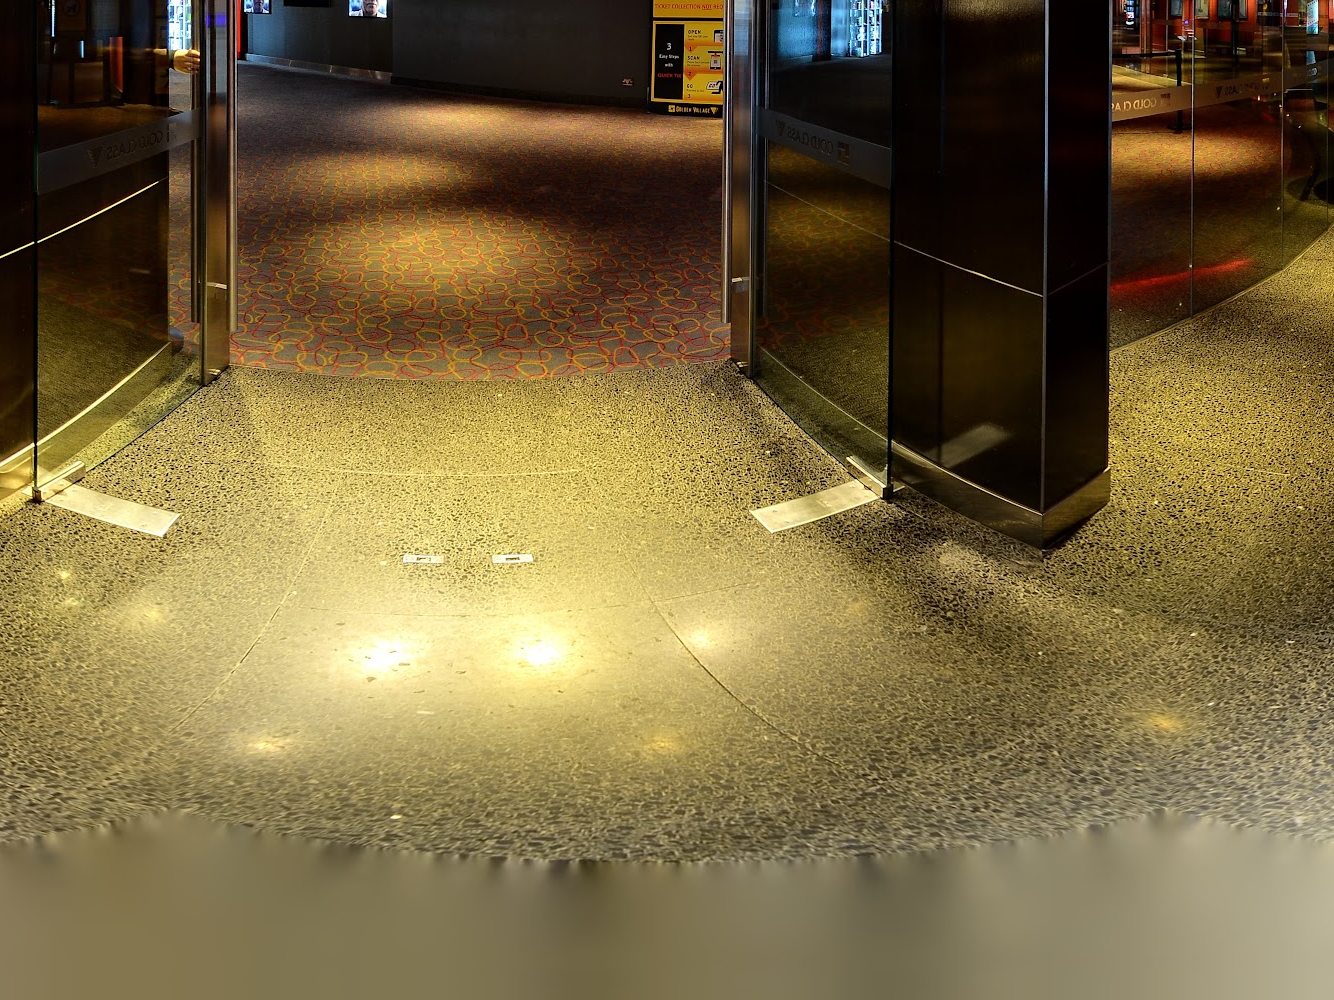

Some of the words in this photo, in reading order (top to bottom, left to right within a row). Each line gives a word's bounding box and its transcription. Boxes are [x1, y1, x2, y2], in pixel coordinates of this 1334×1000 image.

[666, 42, 672, 51] 3
[675, 105, 692, 113] GOLDEN
[692, 106, 711, 114] VILLAGE
